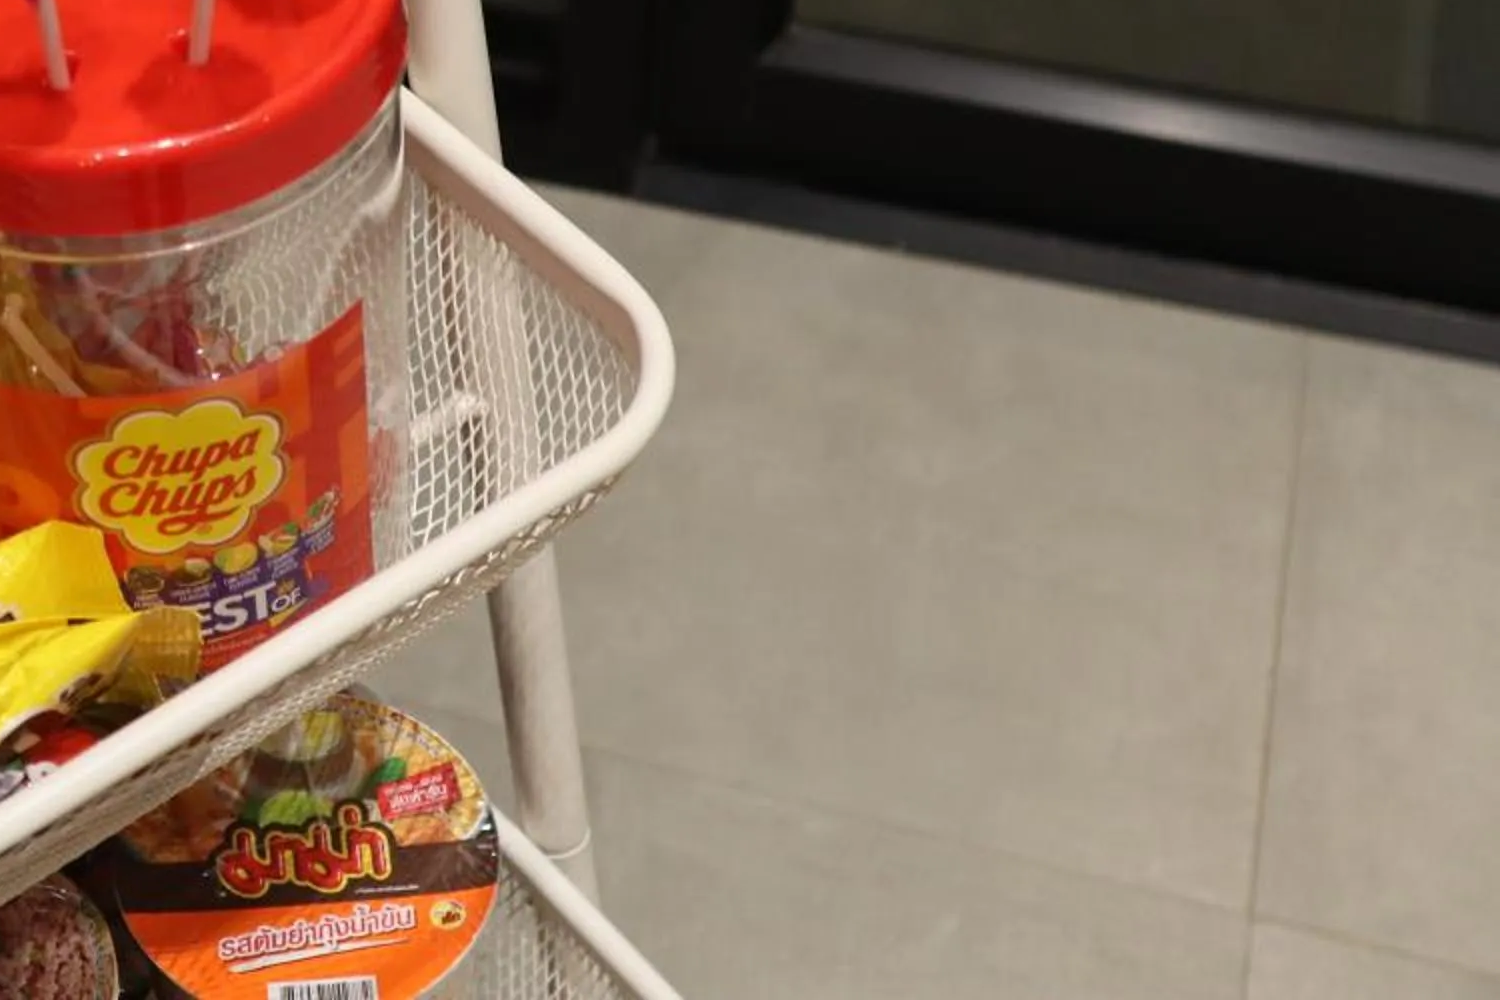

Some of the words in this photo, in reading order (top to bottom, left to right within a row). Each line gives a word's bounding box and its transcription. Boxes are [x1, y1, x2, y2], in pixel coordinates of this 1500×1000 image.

[103, 428, 262, 482] Chupa
[100, 466, 257, 536] Chups
[199, 581, 277, 638] EST
